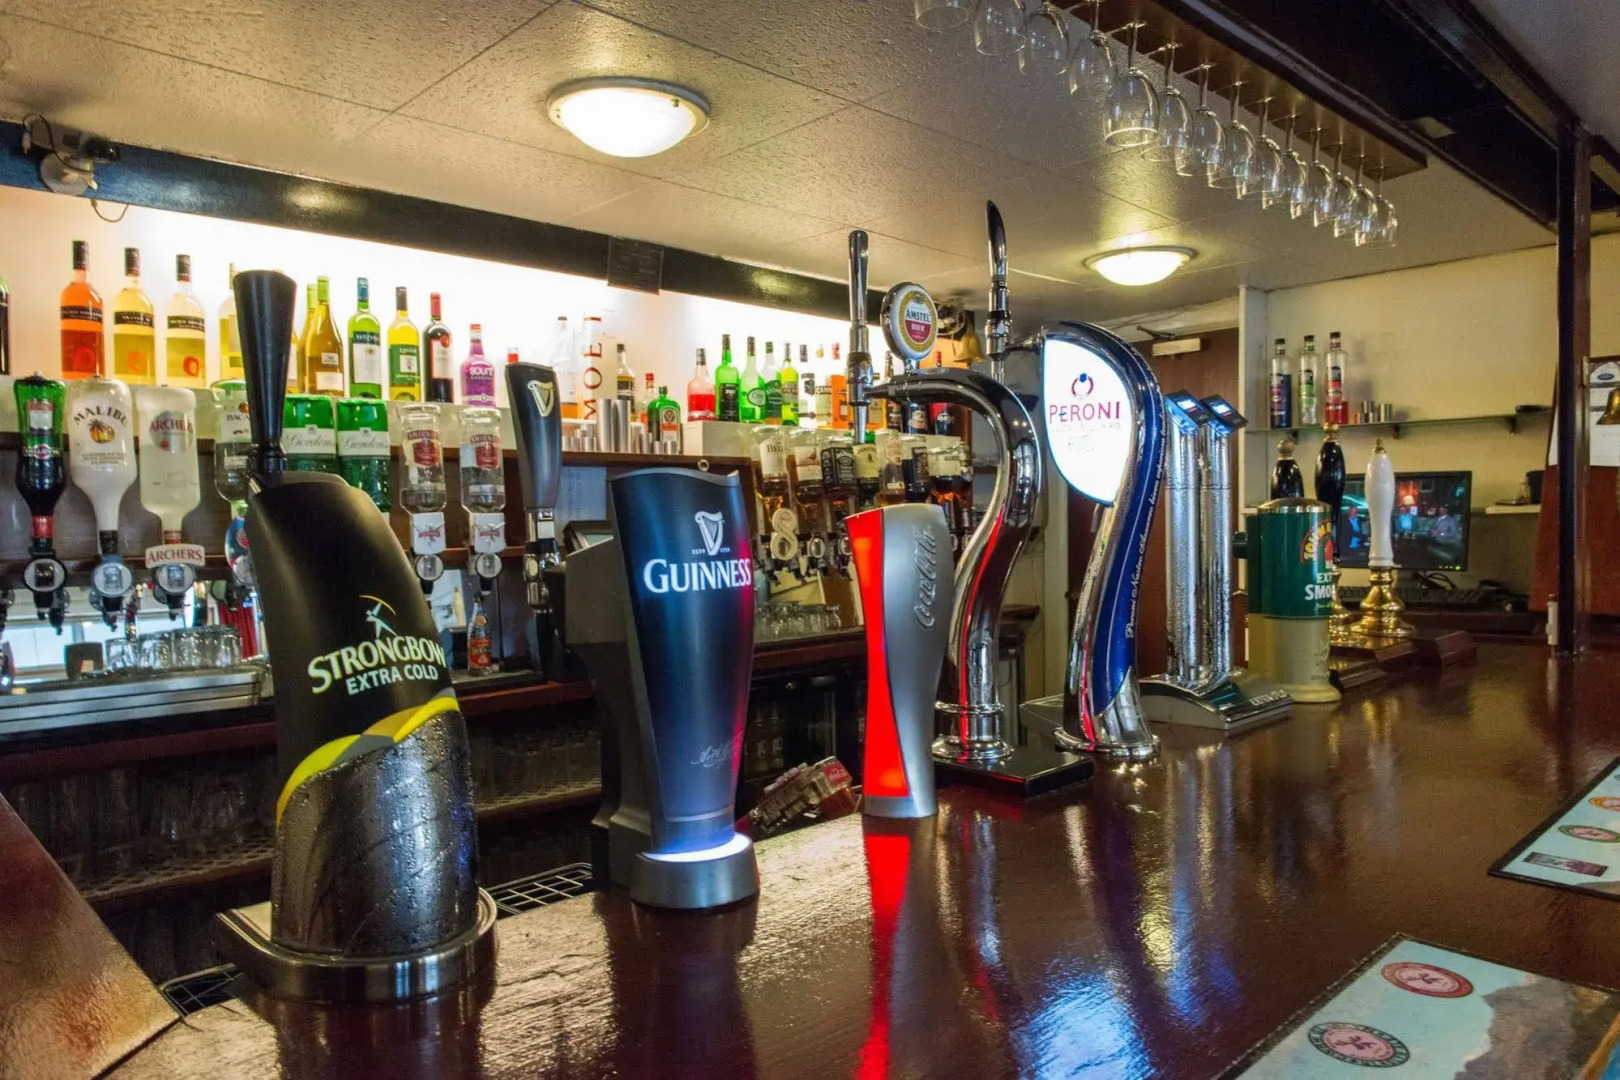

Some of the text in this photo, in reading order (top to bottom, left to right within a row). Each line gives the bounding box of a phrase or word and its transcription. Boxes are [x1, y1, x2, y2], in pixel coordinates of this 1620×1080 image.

[906, 309, 931, 323] AMSTEL
[911, 323, 926, 332] BIER
[73, 405, 128, 427] MALIBU
[1049, 401, 1120, 423] PERONI
[145, 548, 203, 564] ARCHERS
[643, 558, 752, 594] GUINNESS
[307, 635, 447, 694] STRONGBOW
[346, 664, 439, 696] EXTRA COLD
